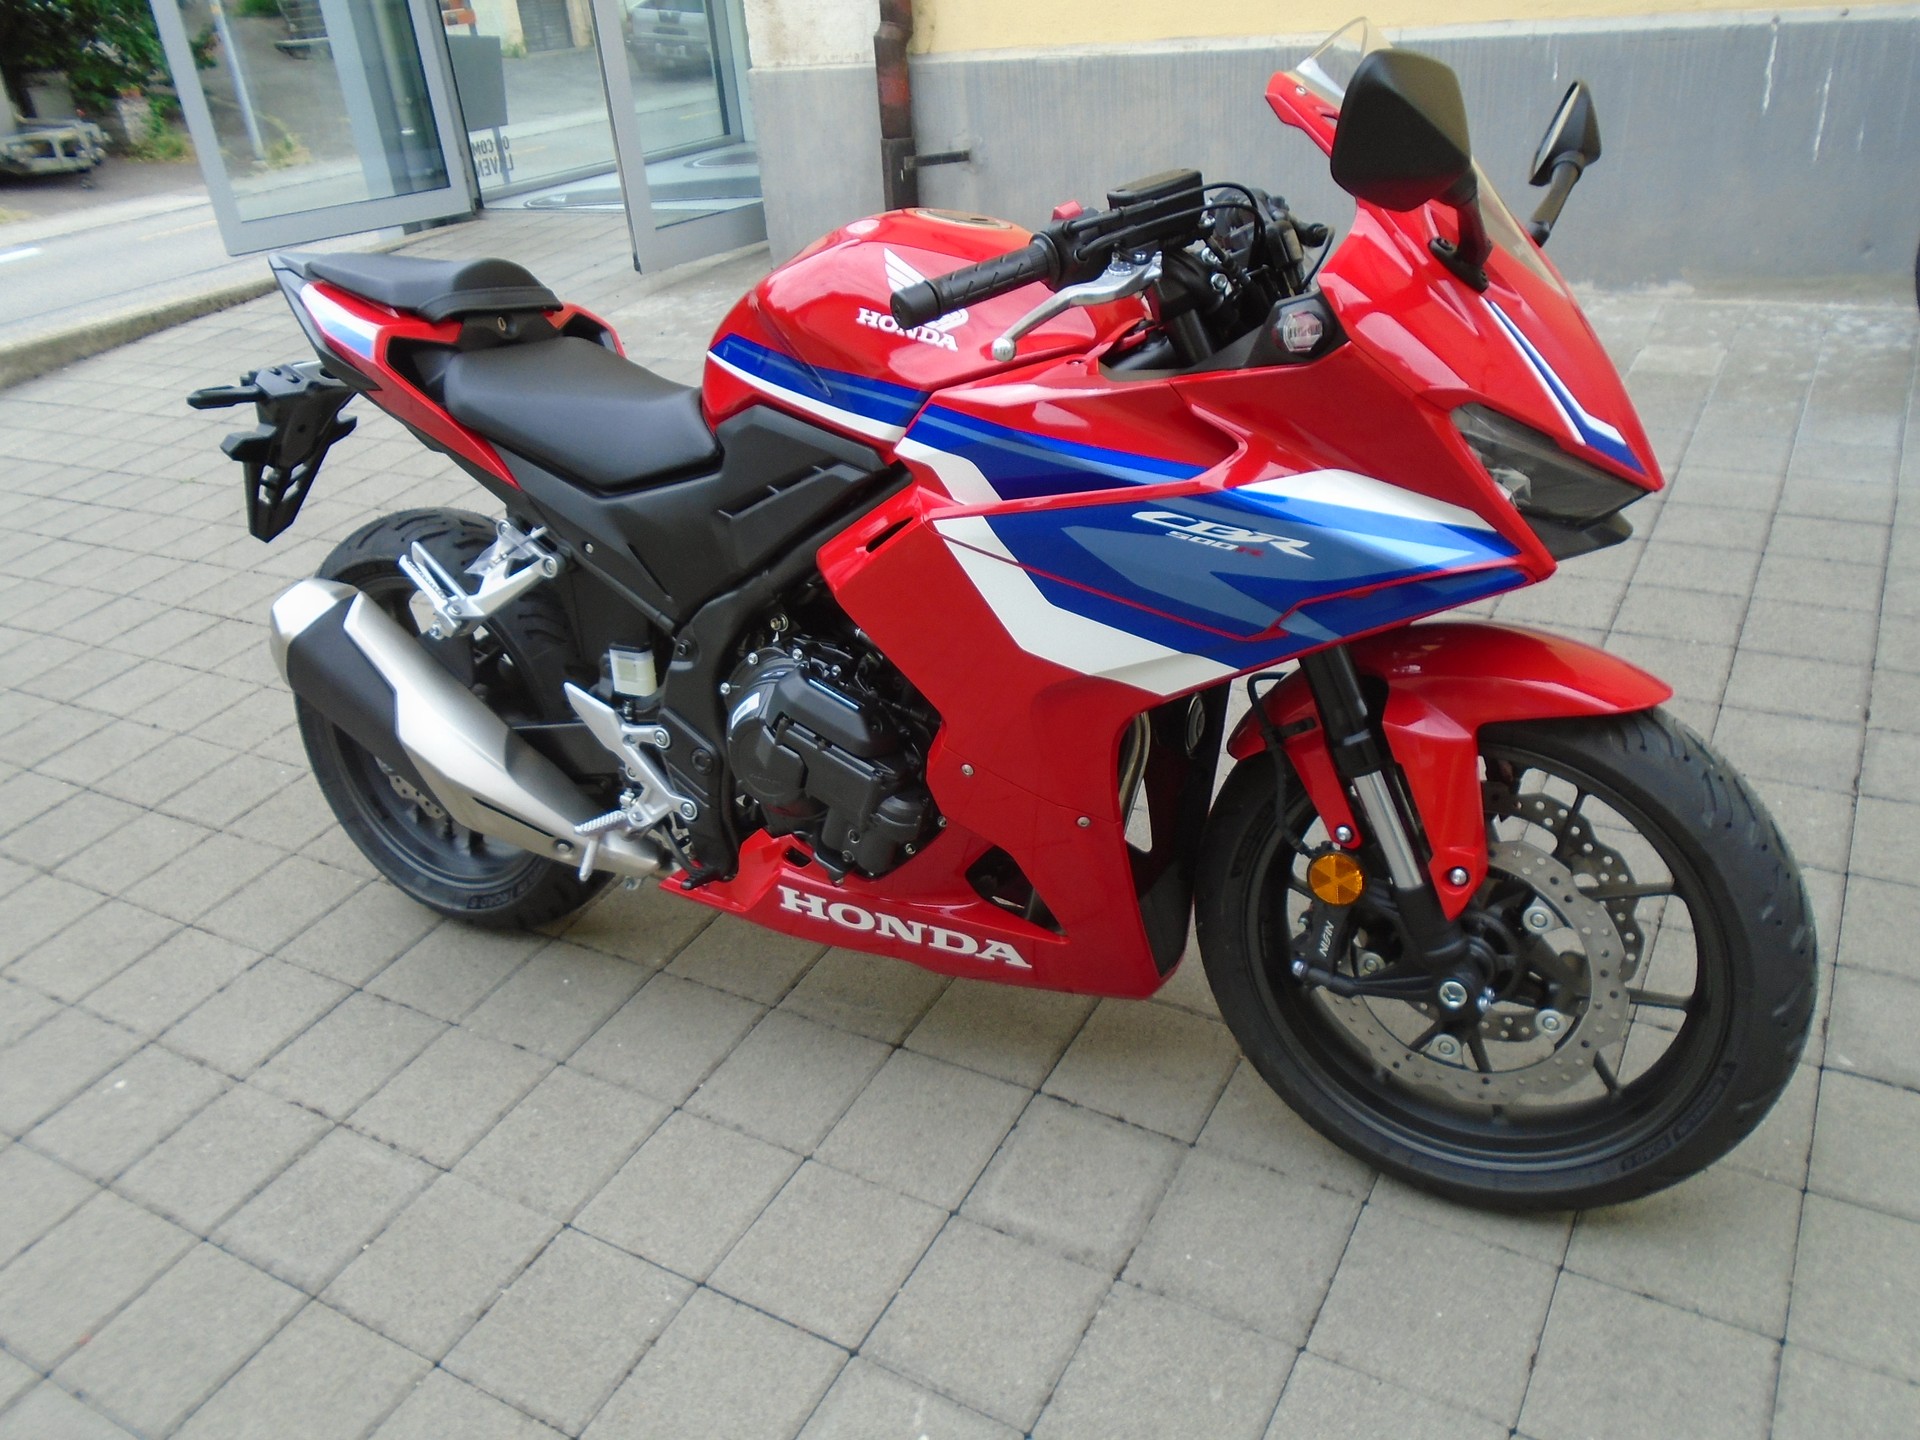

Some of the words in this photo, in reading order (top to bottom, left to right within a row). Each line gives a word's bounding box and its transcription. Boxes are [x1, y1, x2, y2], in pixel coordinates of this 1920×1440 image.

[856, 307, 959, 352] HONDA
[1132, 511, 1315, 560] CBR
[778, 884, 1032, 969] HONDA
